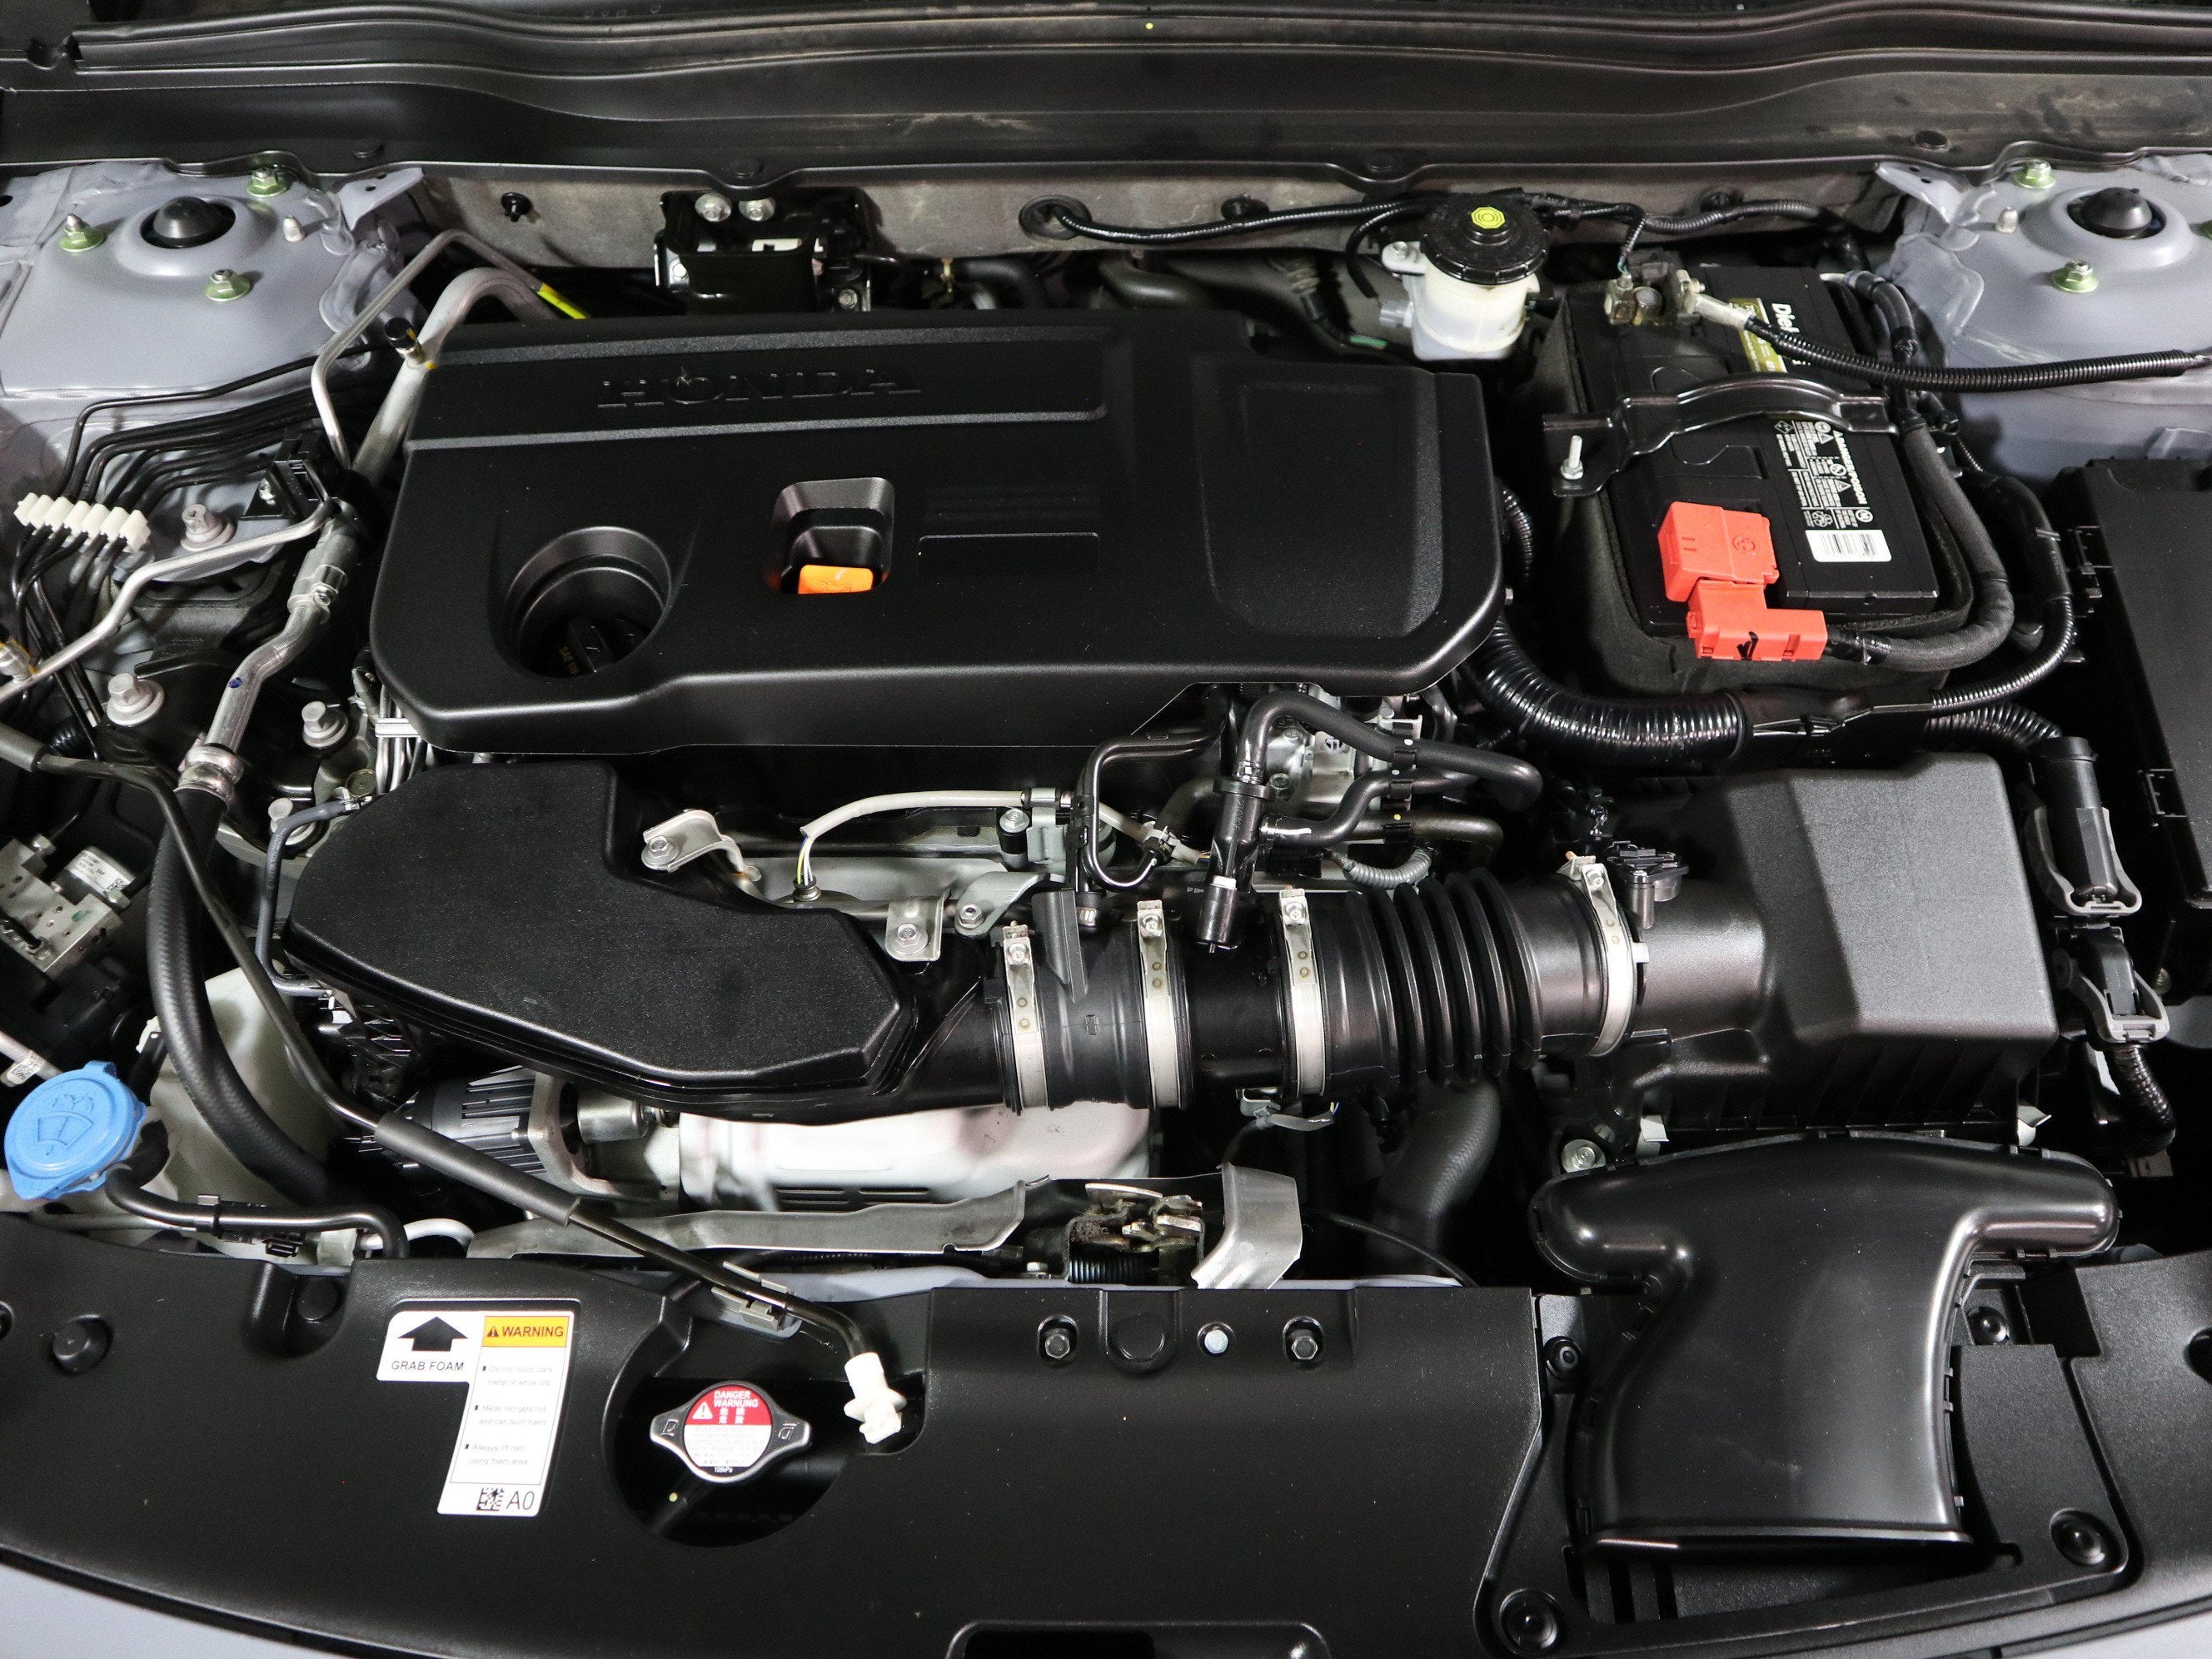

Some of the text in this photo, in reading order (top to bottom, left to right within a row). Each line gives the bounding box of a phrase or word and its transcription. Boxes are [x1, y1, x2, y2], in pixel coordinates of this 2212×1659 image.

[597, 369, 922, 408] HONDA
[502, 1326, 564, 1338] WARNING
[391, 1361, 464, 1371] GRAB FOAM
[714, 1390, 751, 1399] DANGER
[714, 1399, 759, 1407] WARNUNG
[506, 1491, 536, 1511] A0
